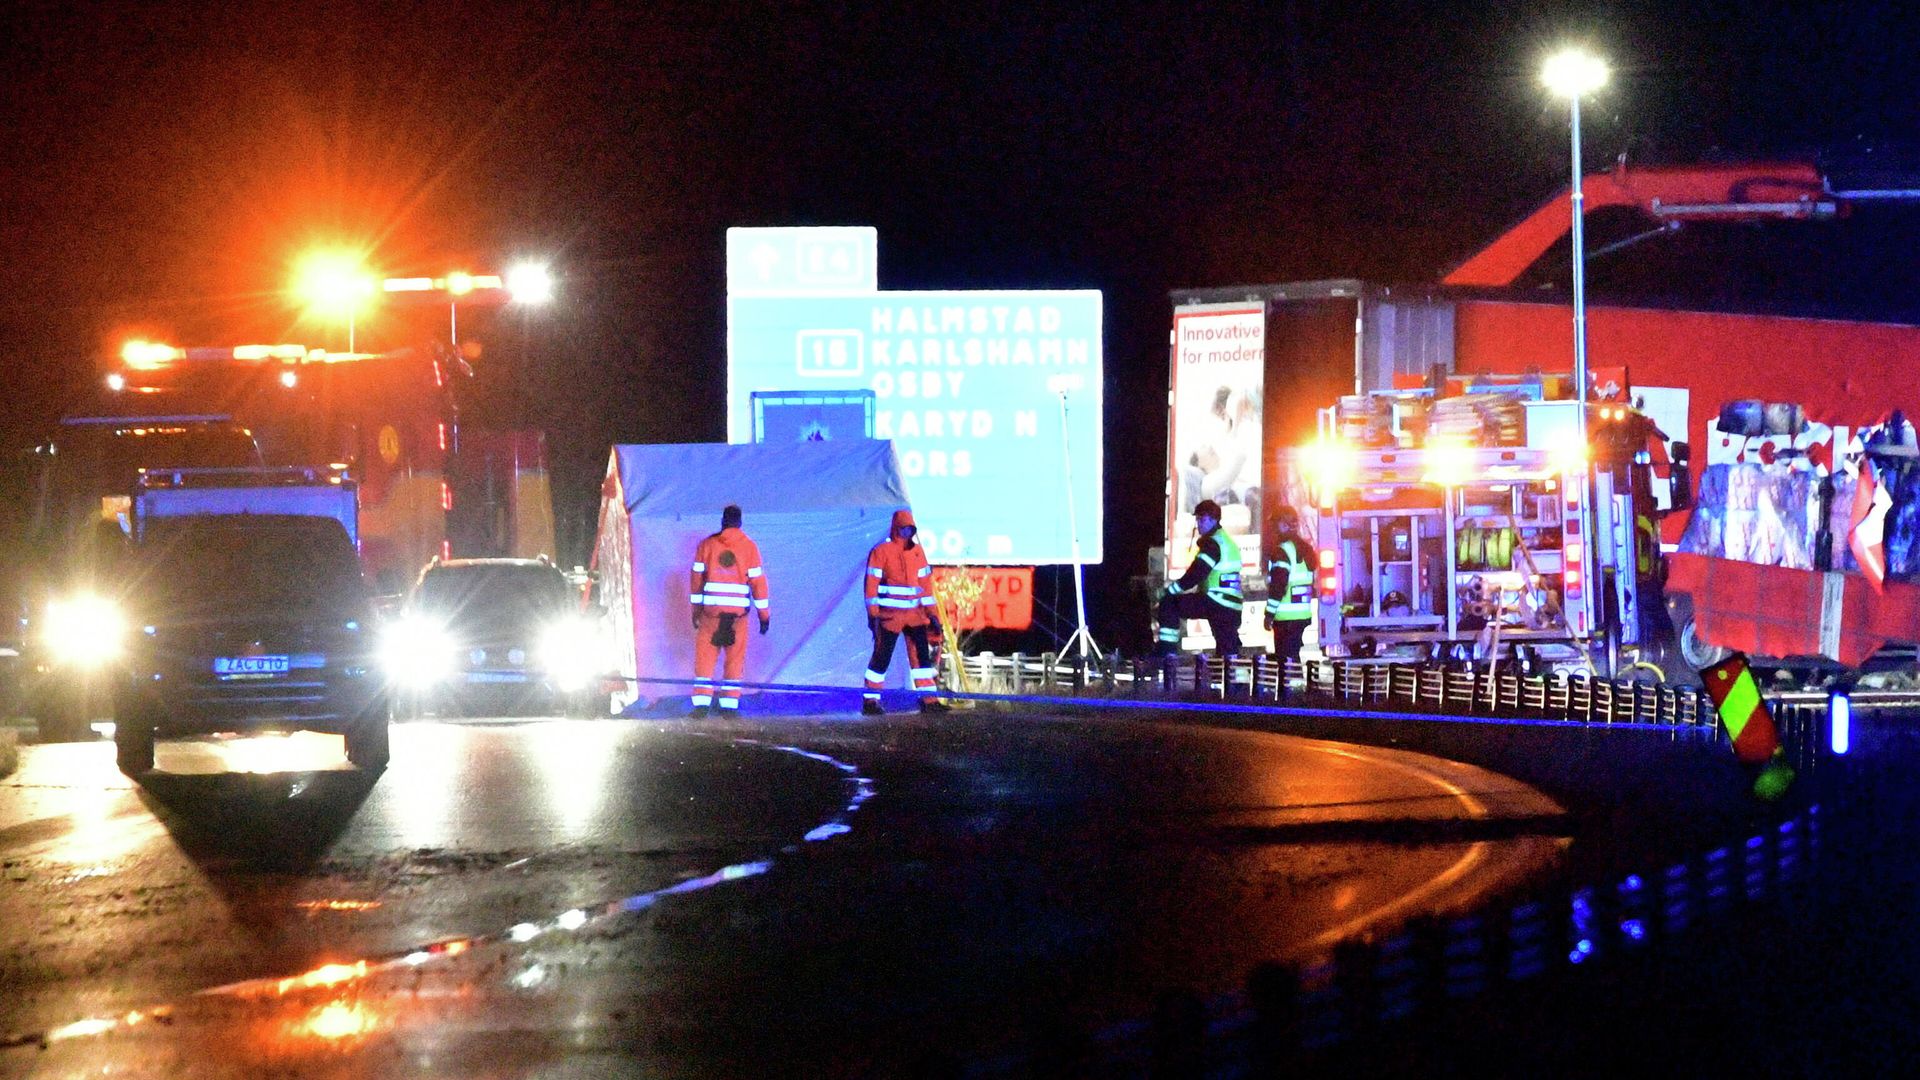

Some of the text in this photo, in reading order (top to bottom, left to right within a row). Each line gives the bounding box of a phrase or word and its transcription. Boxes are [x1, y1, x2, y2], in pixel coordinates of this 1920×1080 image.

[871, 306, 1061, 334] HALMSTAD
[1182, 322, 1261, 342] Innovative
[871, 338, 1089, 367] KARLSHAMN
[1182, 344, 1264, 364] for modern
[872, 371, 965, 399] OSBY
[876, 409, 1038, 438] KARYD N
[902, 449, 973, 478] ORS
[920, 528, 965, 556] 00
